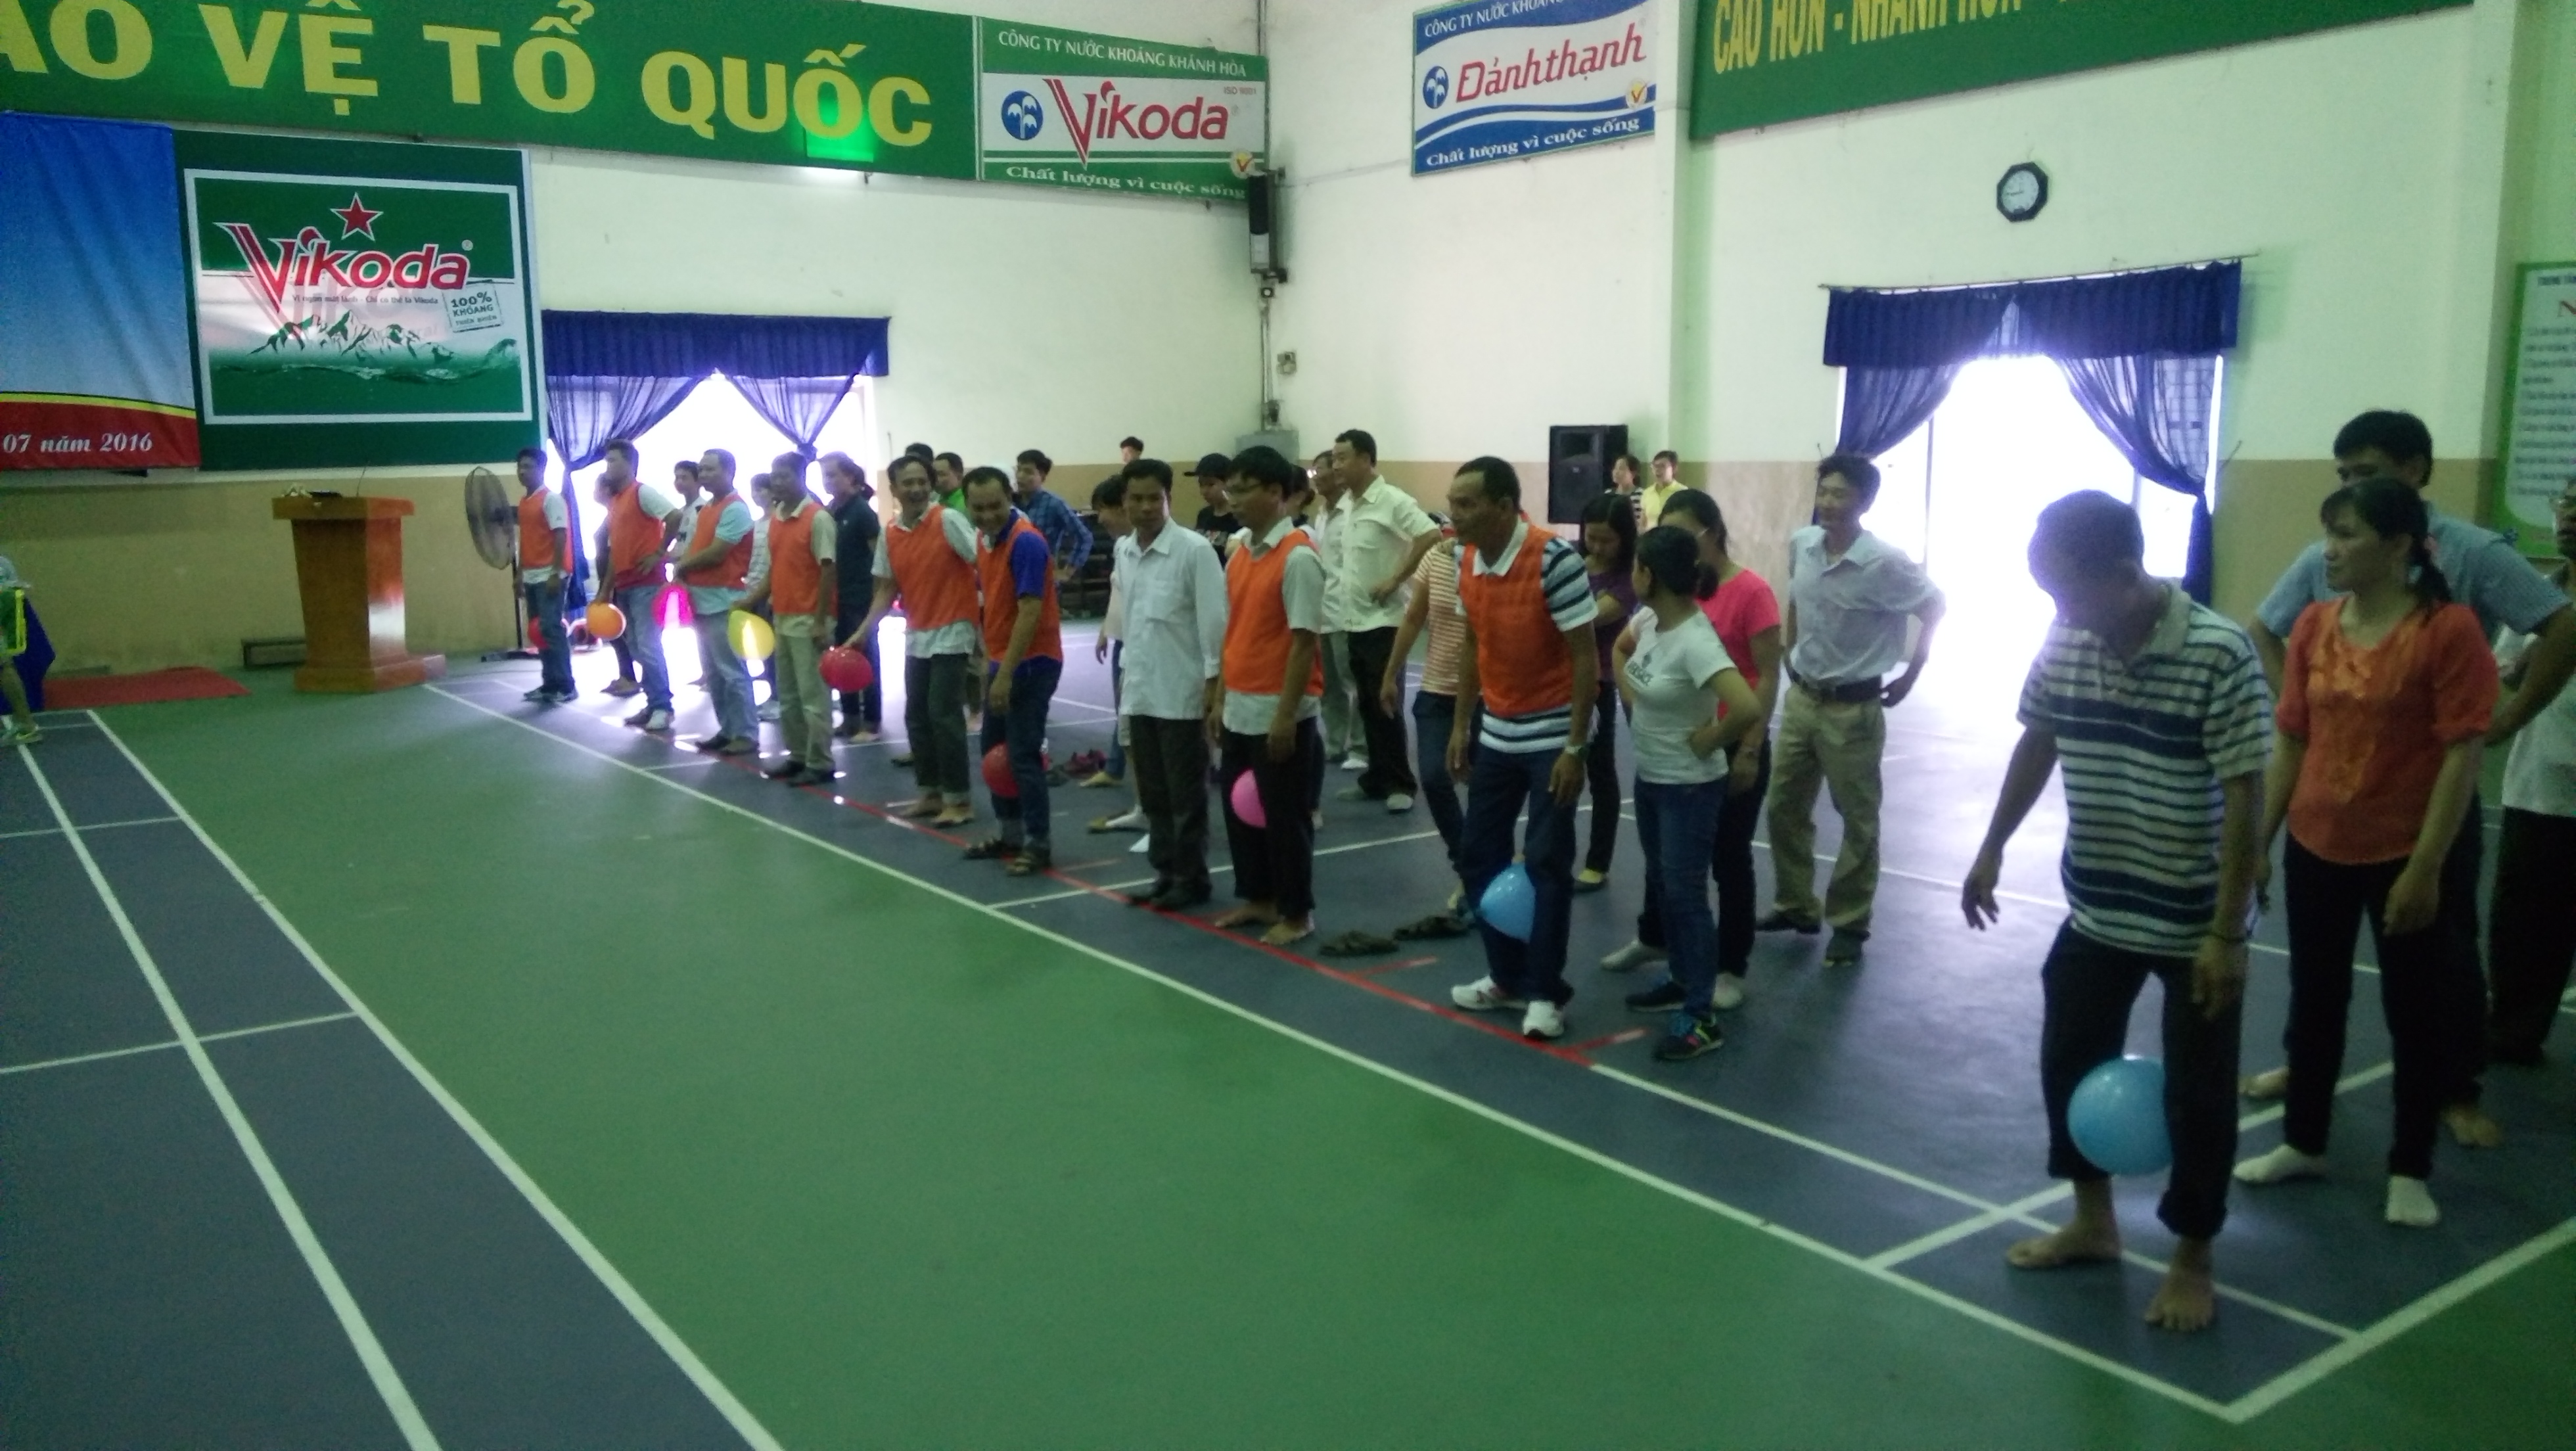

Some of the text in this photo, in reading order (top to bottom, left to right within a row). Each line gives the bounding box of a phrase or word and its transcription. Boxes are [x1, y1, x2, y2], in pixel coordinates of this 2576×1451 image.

[1425, 18, 1457, 37] CÔNG
[1460, 14, 1473, 28] TY
[998, 28, 1040, 50] CÔNG
[1044, 37, 1061, 52] TY
[1066, 39, 1105, 58] NƯỚC
[1108, 47, 1165, 66] KHOÁNG
[1169, 54, 1216, 73] KHÁNH
[199, 0, 379, 116] VỆ
[423, 0, 595, 113] TỔ
[641, 43, 932, 147] QUỐC
[1042, 78, 1228, 168] Vikoda
[1427, 118, 1640, 166] Chất lượng vì cuộc sống
[1006, 166, 1055, 181] Chất
[1063, 170, 1120, 189] lượng
[1126, 177, 1144, 189] vì
[1150, 181, 1195, 194] cuộc
[213, 222, 469, 313] Vikoda
[451, 292, 492, 308] 100%
[3, 432, 152, 453] 07 năm 2016
